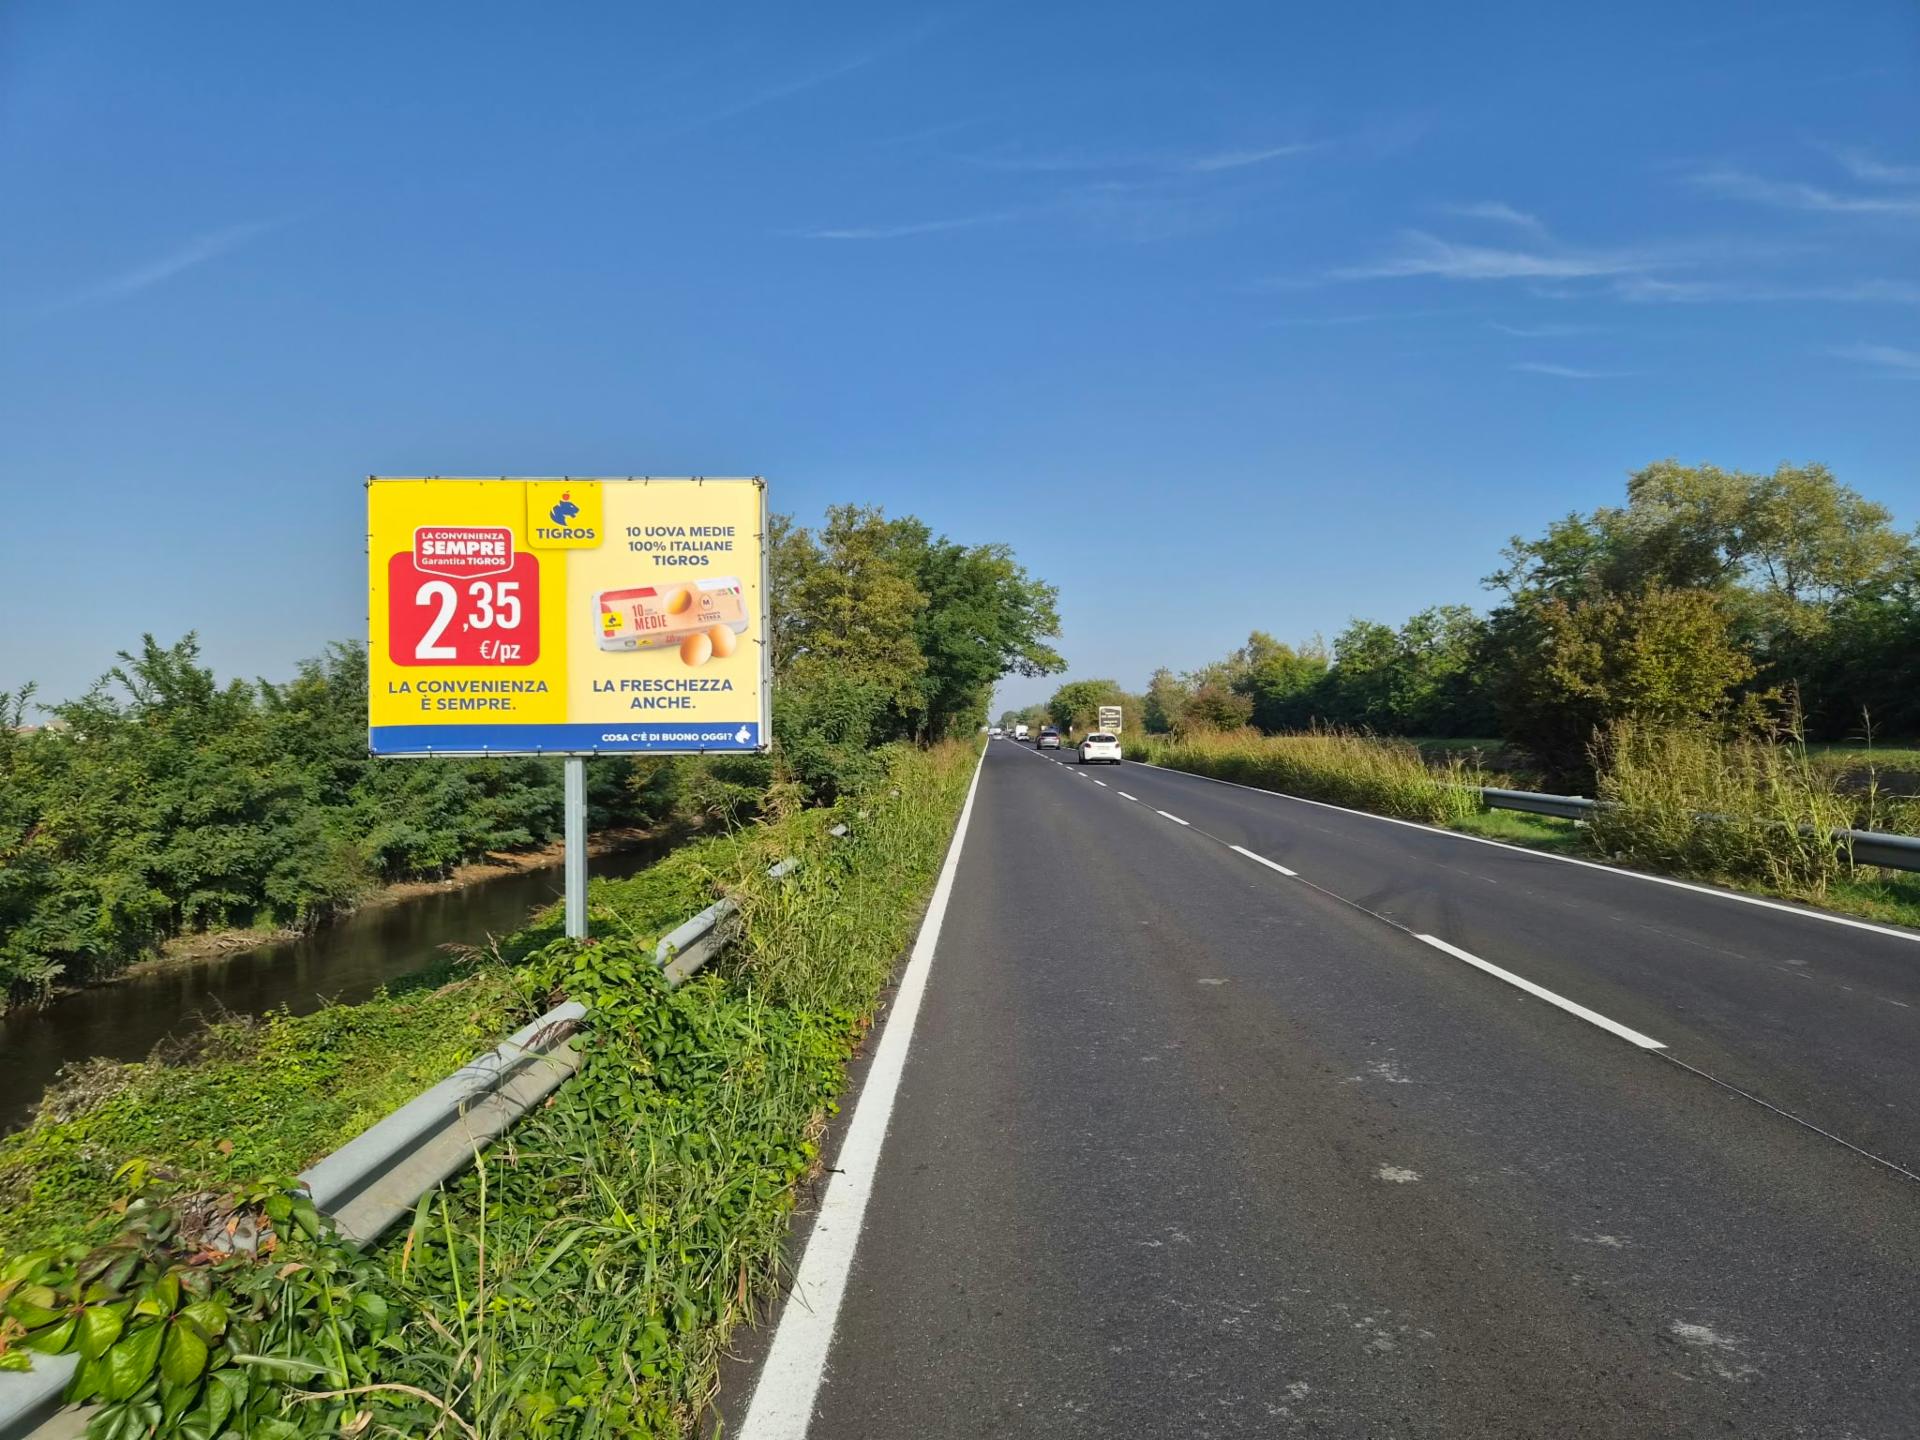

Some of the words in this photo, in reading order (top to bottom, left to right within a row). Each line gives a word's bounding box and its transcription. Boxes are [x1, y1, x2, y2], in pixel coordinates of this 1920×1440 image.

[422, 532, 433, 540] LA
[435, 532, 504, 540] CONVENIENZA
[536, 528, 595, 539] TIGROS
[626, 526, 641, 537] 10
[644, 526, 687, 537] UOVA
[689, 526, 735, 537] MEDIE
[422, 541, 505, 555] SEMPRE
[628, 541, 666, 552] 100%
[670, 541, 733, 552] ITALIANE
[422, 557, 465, 565] Garantita
[467, 557, 506, 565] TIGROS
[652, 555, 709, 566] TIGROS
[632, 604, 644, 617] 10
[634, 614, 667, 631] MEDIE
[480, 640, 521, 663] €/pz
[388, 681, 411, 693] LA
[416, 681, 548, 693] CONVENIENZA
[592, 680, 615, 692] LA
[620, 679, 733, 692] FRESCHEZZA
[421, 694, 431, 710] È
[436, 697, 516, 710] SEMPRE.
[630, 696, 697, 709] ANCHE.
[602, 733, 629, 742] COSA
[649, 733, 660, 741] DI
[661, 733, 699, 741] BUONO
[701, 732, 733, 741] OGGI?
